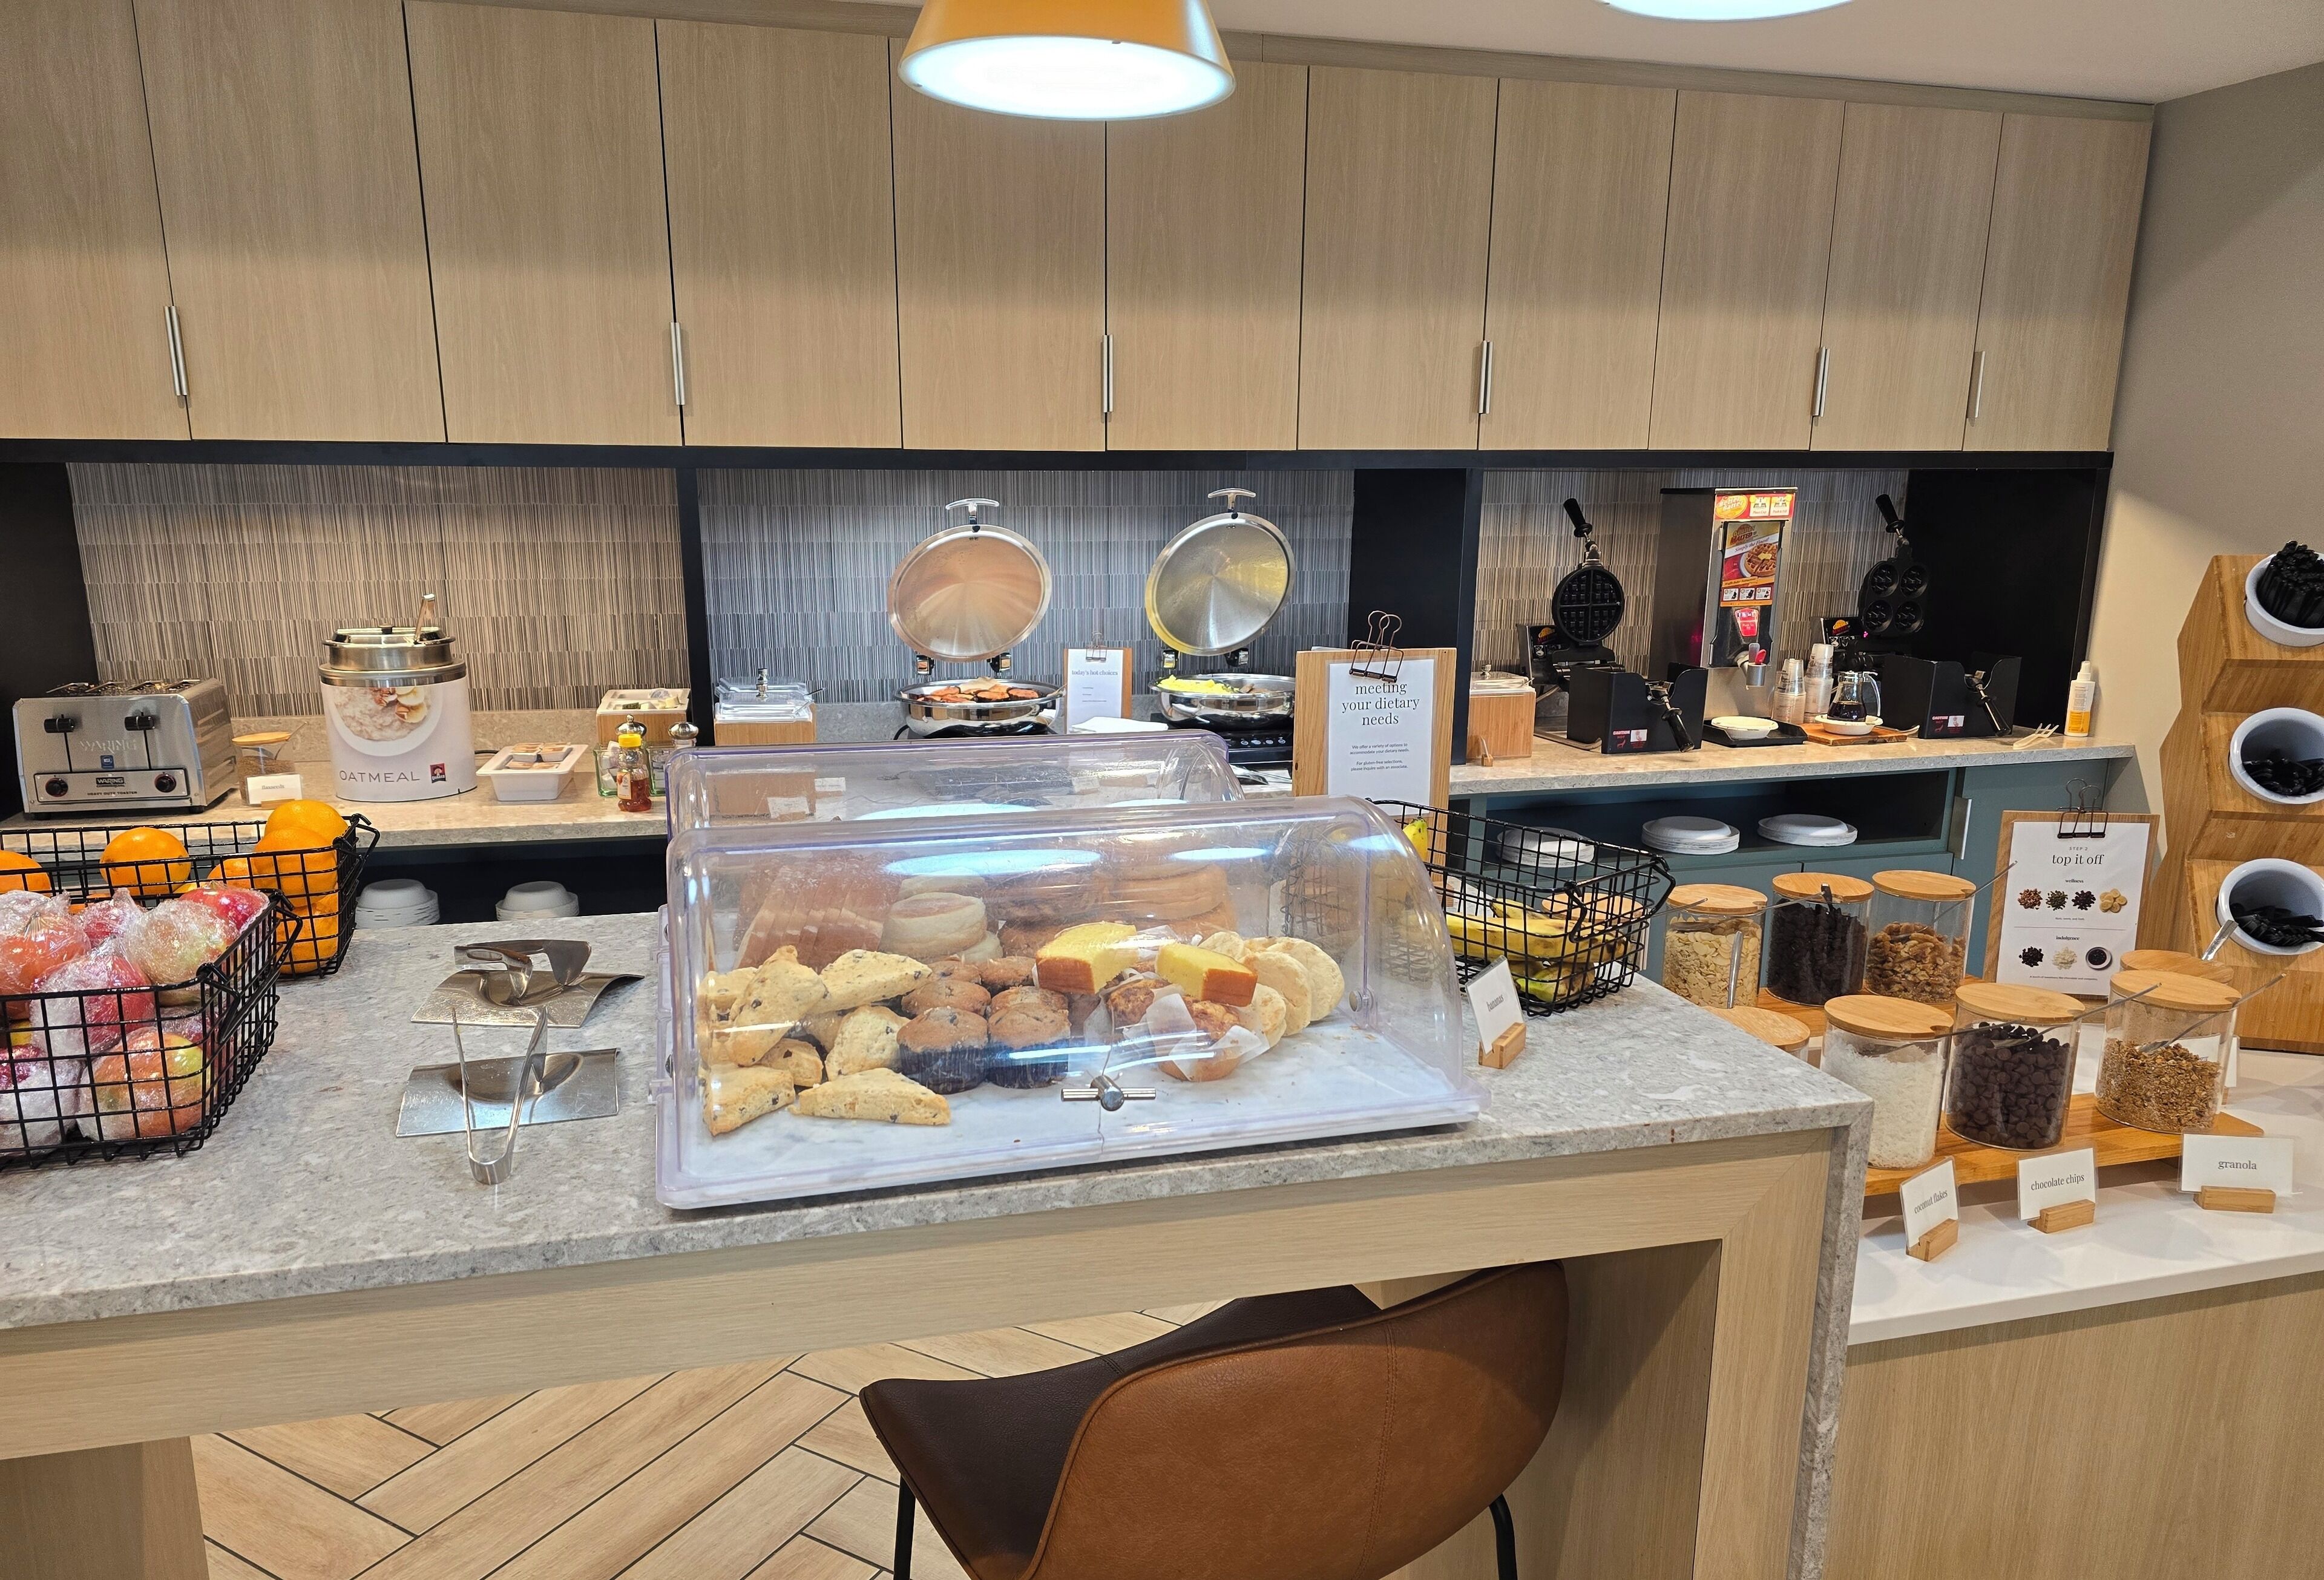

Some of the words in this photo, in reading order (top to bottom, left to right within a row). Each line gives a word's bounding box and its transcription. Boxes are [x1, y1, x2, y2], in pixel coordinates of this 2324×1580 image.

[1356, 681, 1407, 695] meeting
[1342, 701, 1371, 713] your
[1375, 698, 1420, 710] dietary
[1362, 713, 1399, 726] needs
[339, 770, 420, 782] OATMEAL
[2052, 854, 2071, 866] top
[2075, 854, 2084, 865] it
[2087, 854, 2104, 865] off
[1486, 994, 1504, 1012] bananas
[2217, 1160, 2257, 1170] granola
[2030, 1177, 2064, 1190] chocolate
[2066, 1173, 2084, 1184] chips
[1914, 1196, 1933, 1214] coconut
[1933, 1189, 1948, 1204] flakes
